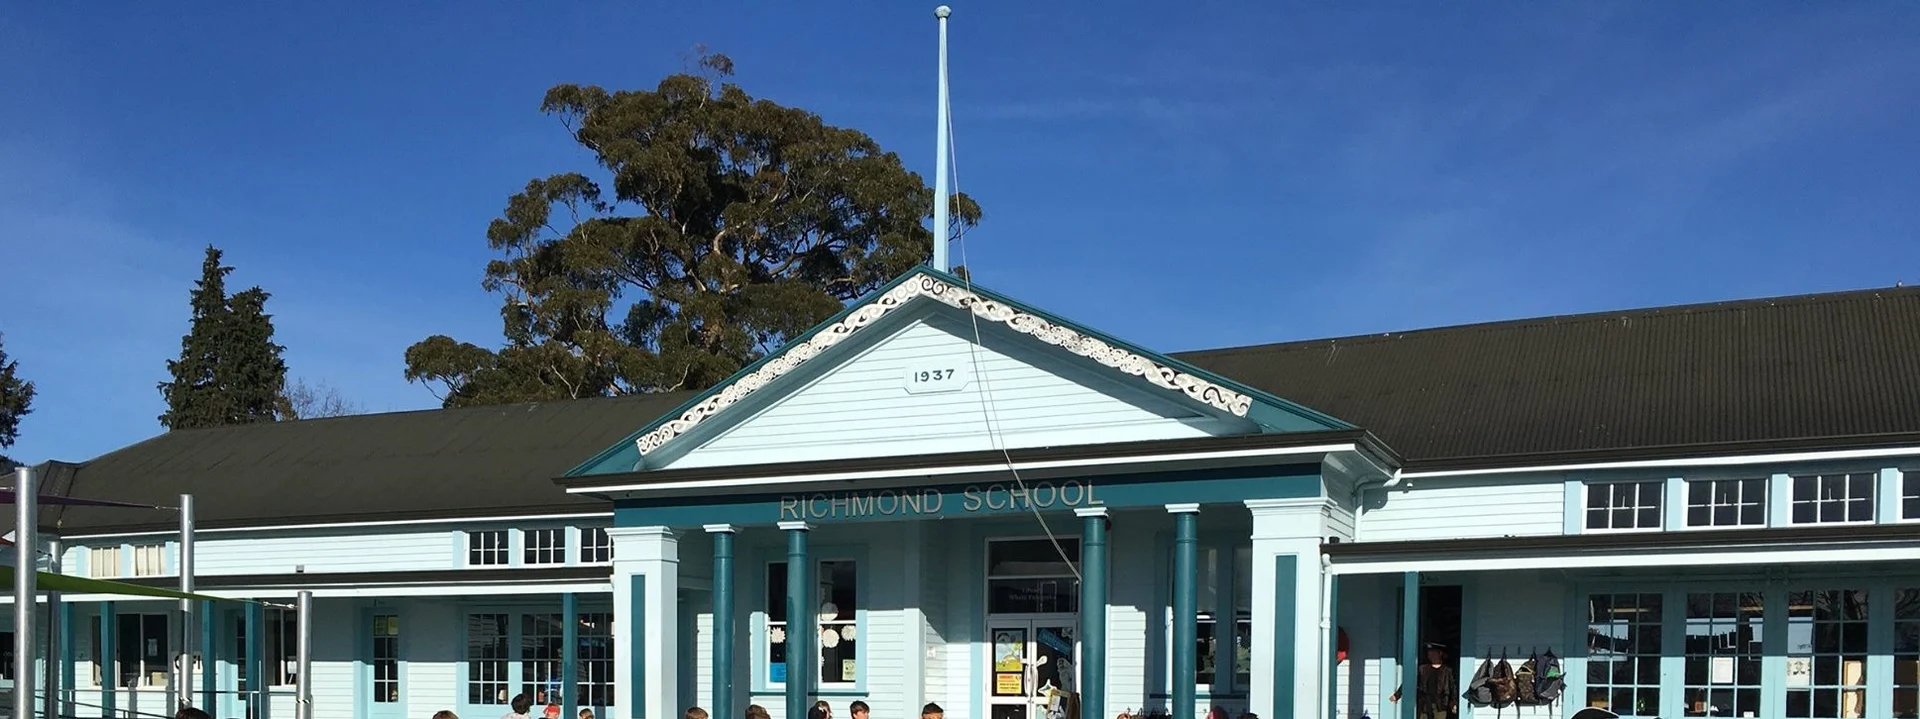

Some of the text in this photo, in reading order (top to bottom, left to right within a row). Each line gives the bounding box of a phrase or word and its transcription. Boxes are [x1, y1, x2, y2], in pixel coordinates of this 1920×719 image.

[914, 368, 955, 383] 1937
[780, 480, 1104, 519] RICHMOND SCHOOL
